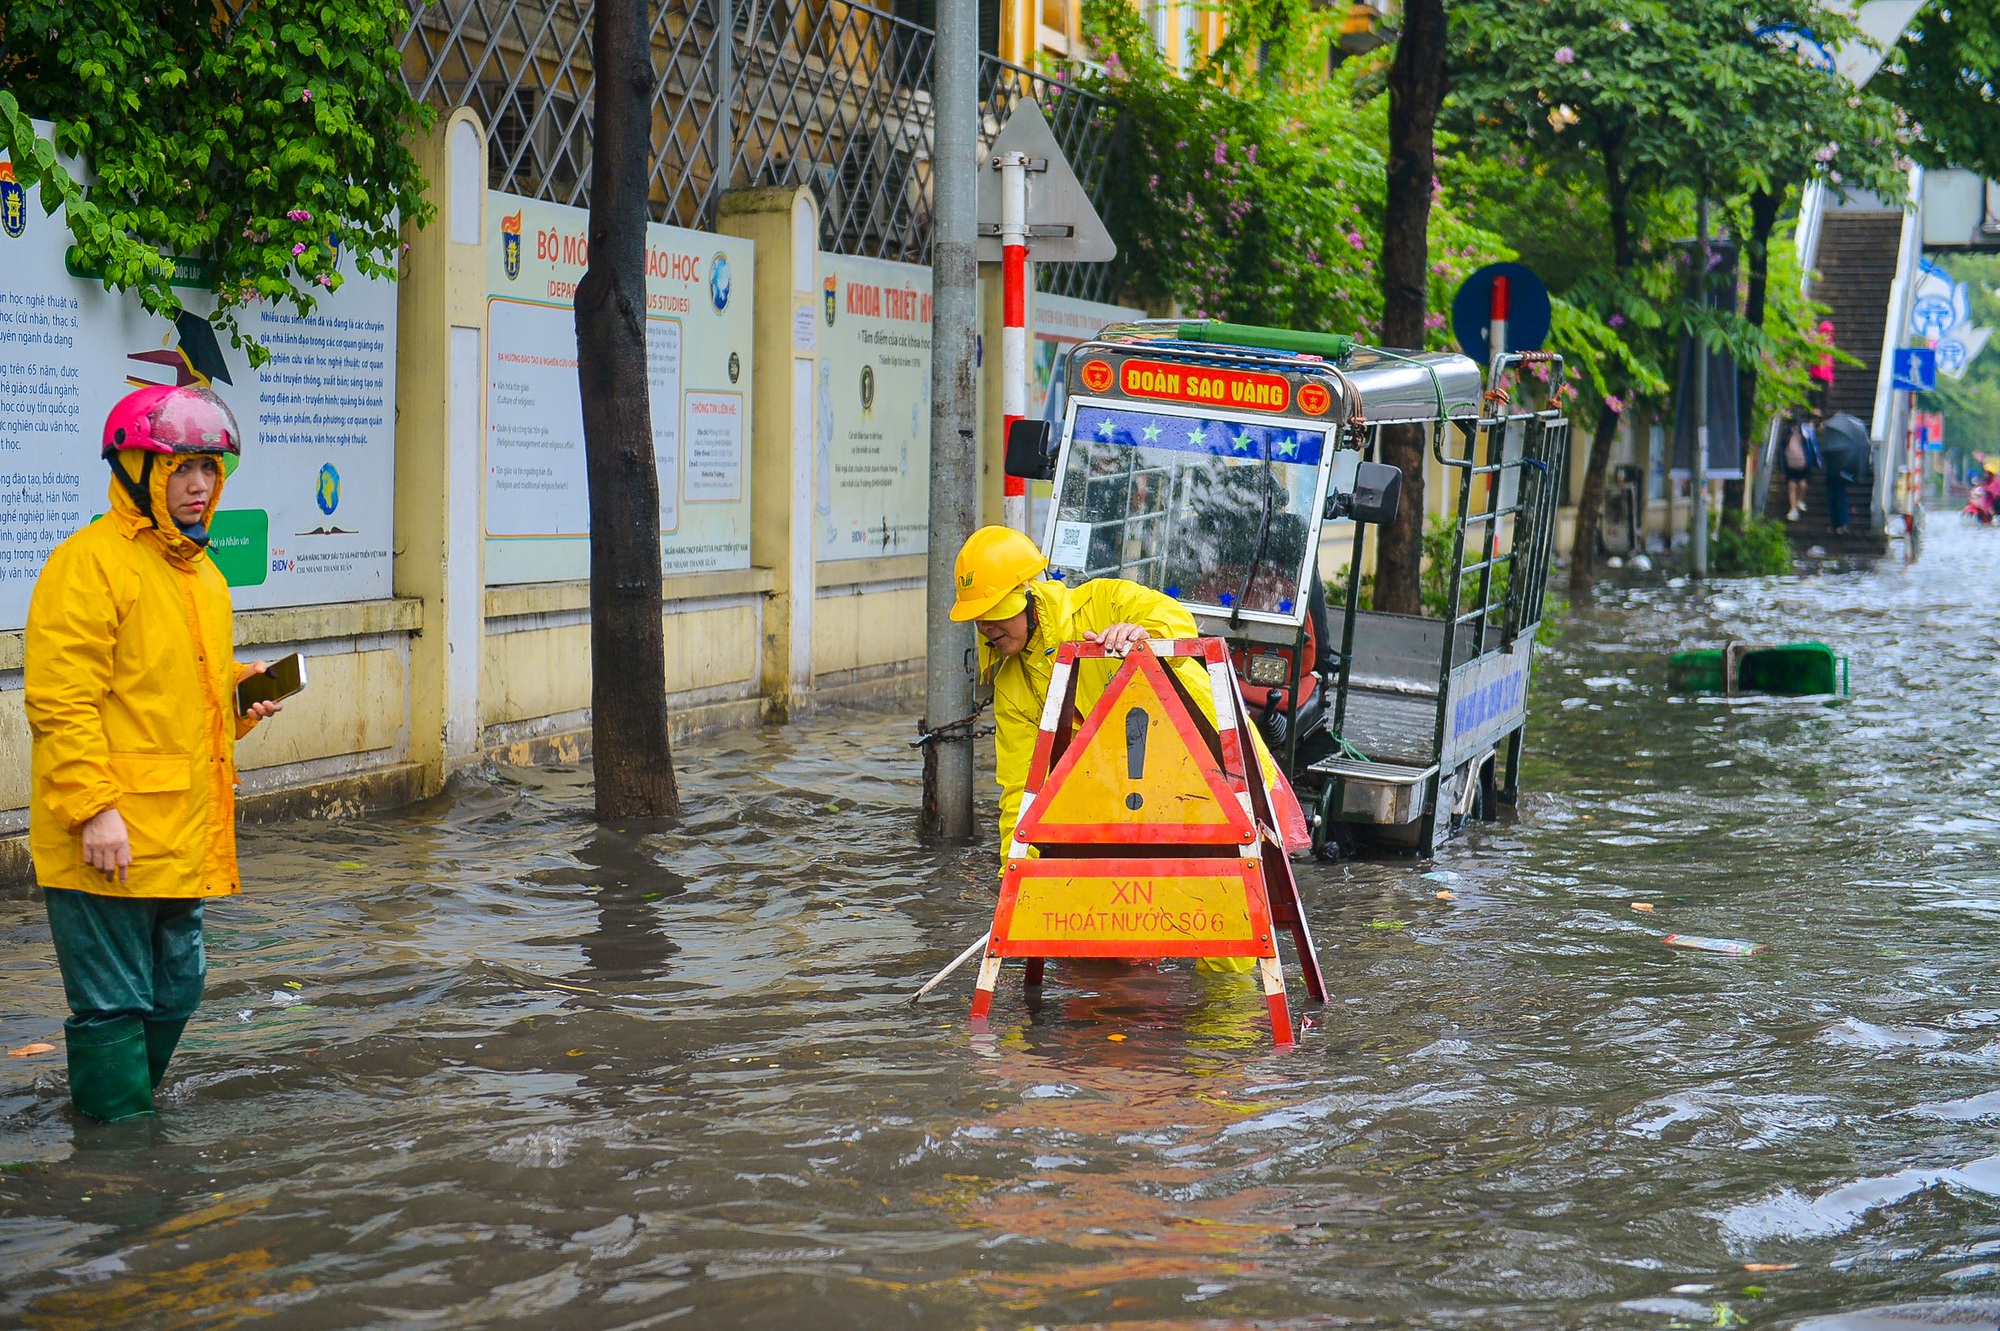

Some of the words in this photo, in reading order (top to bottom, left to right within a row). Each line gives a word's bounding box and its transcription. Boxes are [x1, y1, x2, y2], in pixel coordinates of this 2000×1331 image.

[537, 227, 559, 270] BỘ
[563, 232, 588, 267] MÔ
[645, 244, 668, 278] IÁO
[672, 253, 700, 289] HỌC
[9, 291, 23, 307] học
[26, 293, 45, 309] nghệ
[47, 294, 67, 311] thuật
[69, 297, 78, 309] và
[647, 293, 656, 309] US
[658, 295, 690, 314] STUDIES)
[847, 281, 880, 317] KHOA
[884, 280, 916, 321] TRIẾT
[52, 313, 69, 329] thạc
[18, 331, 42, 345] ngành
[54, 333, 73, 348] dạng
[9, 362, 25, 375] trên
[27, 363, 37, 376] 65
[11, 382, 28, 397] giáo
[1127, 368, 1180, 395] ĐOÀN
[1186, 376, 1224, 399] SAO
[1231, 378, 1283, 406] VÀNG
[48, 400, 67, 416] quốc
[7, 419, 34, 434] nghiên
[1, 491, 21, 506] nghệ
[45, 491, 60, 503] Hán
[61, 491, 80, 503] Nôm
[18, 509, 45, 525] nghiệp
[46, 509, 60, 521] liên
[61, 511, 80, 524] quan
[16, 528, 37, 544] giảng
[14, 549, 33, 562] trong
[272, 559, 288, 572] BIDV
[1110, 880, 1153, 905] XN
[1042, 905, 1109, 932] THOÁT
[1111, 908, 1174, 933] NƯỚC
[1210, 912, 1225, 933] 6
